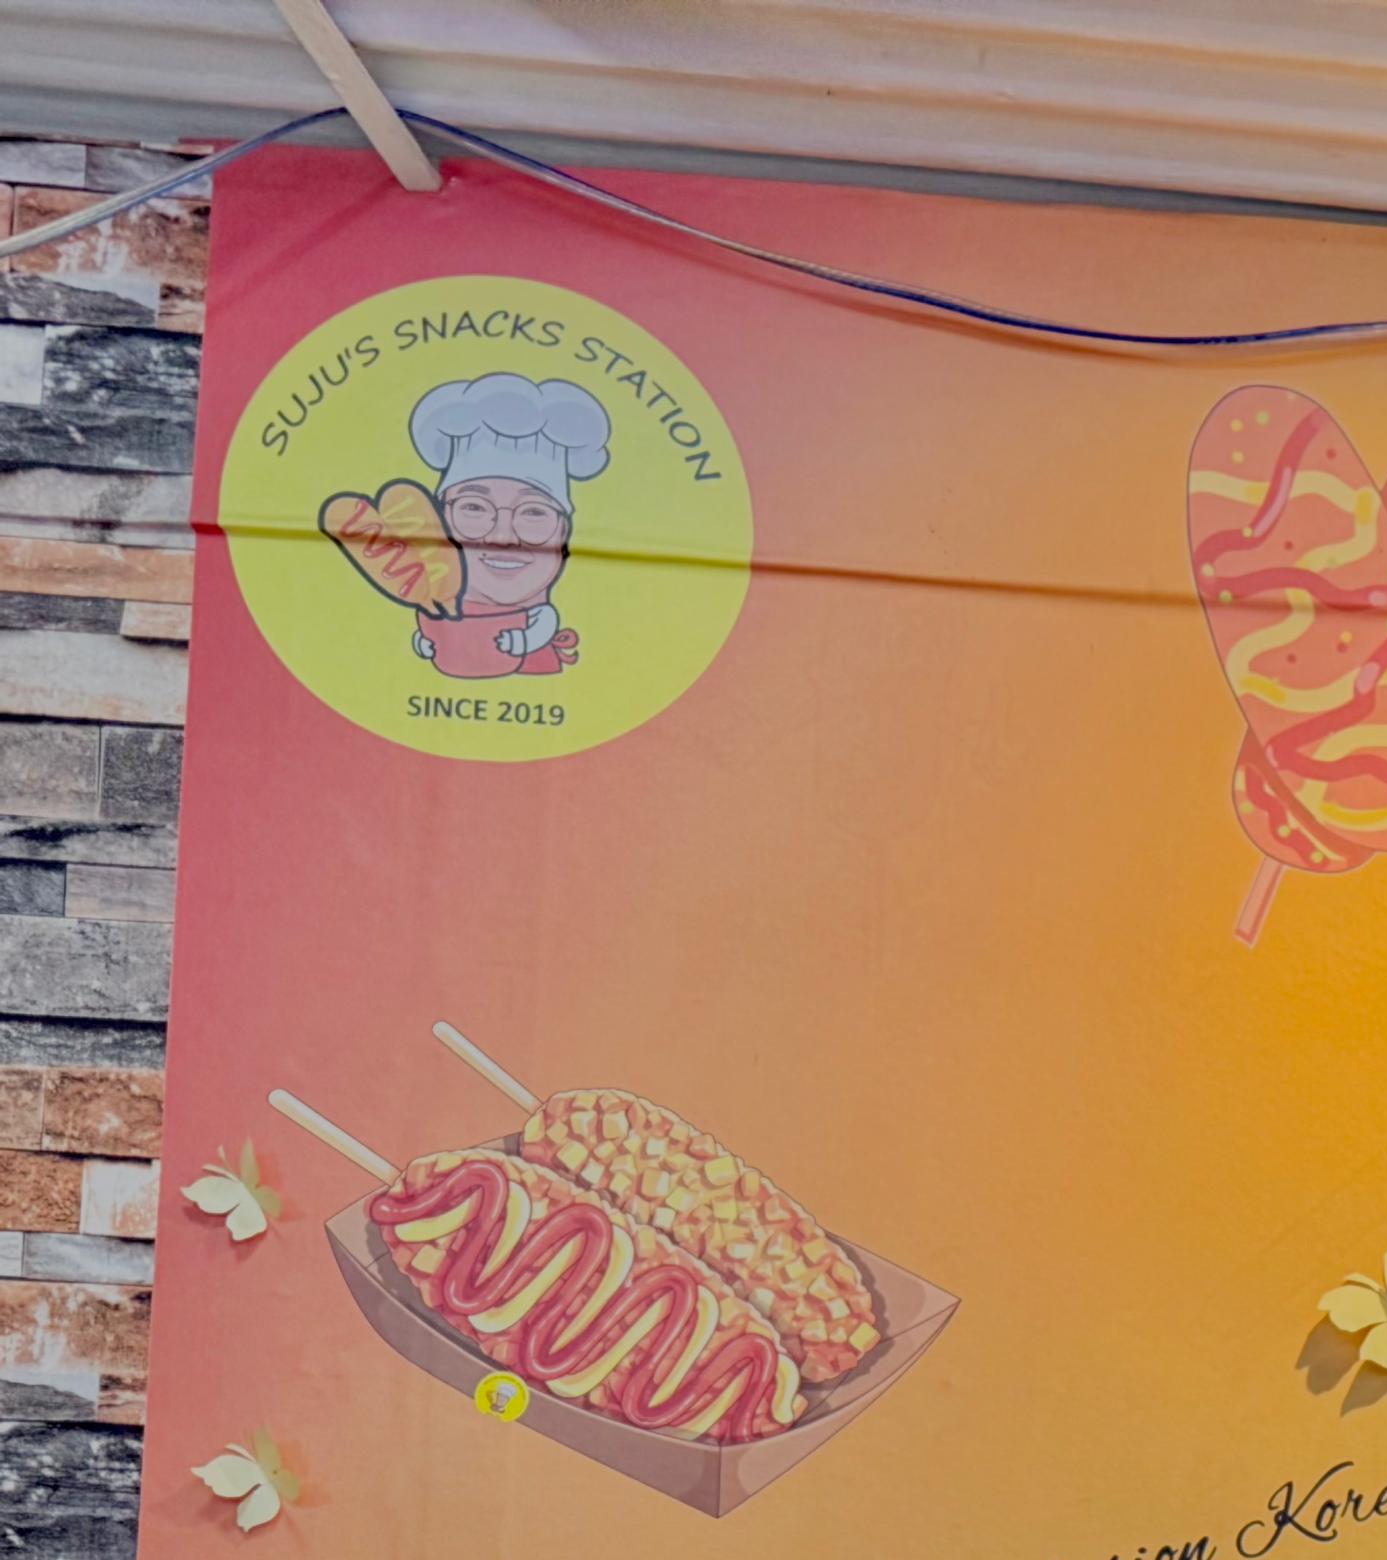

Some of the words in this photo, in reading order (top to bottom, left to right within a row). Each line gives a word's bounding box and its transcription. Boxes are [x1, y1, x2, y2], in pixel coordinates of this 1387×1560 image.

[261, 334, 381, 457] SUJU'S
[393, 309, 565, 351] SNACKS
[574, 336, 722, 483] STATION
[406, 695, 489, 721] SINCE
[496, 701, 566, 726] 2019
